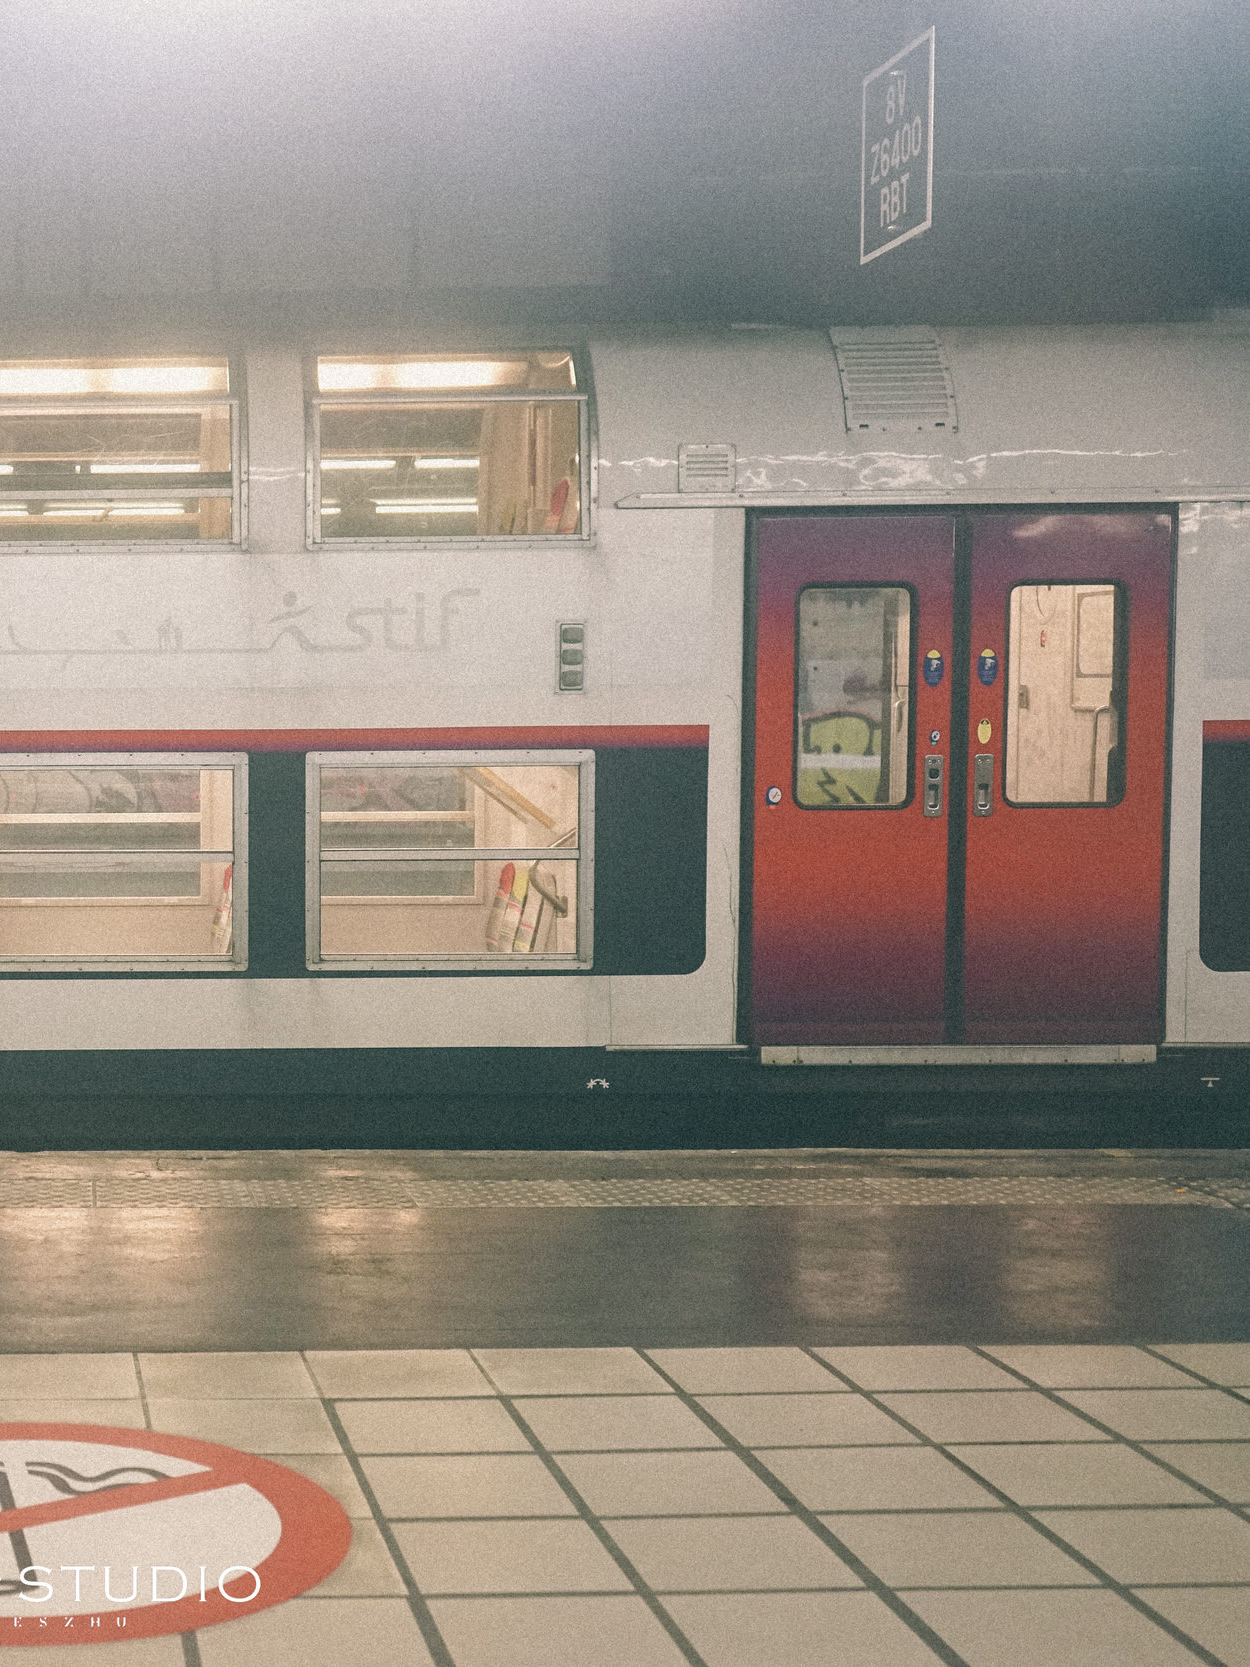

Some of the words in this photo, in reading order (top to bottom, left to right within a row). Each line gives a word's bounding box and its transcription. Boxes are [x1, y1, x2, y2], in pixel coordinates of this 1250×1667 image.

[871, 115, 922, 184] Z6400
[880, 172, 910, 228] RBT
[346, 588, 481, 651] stif
